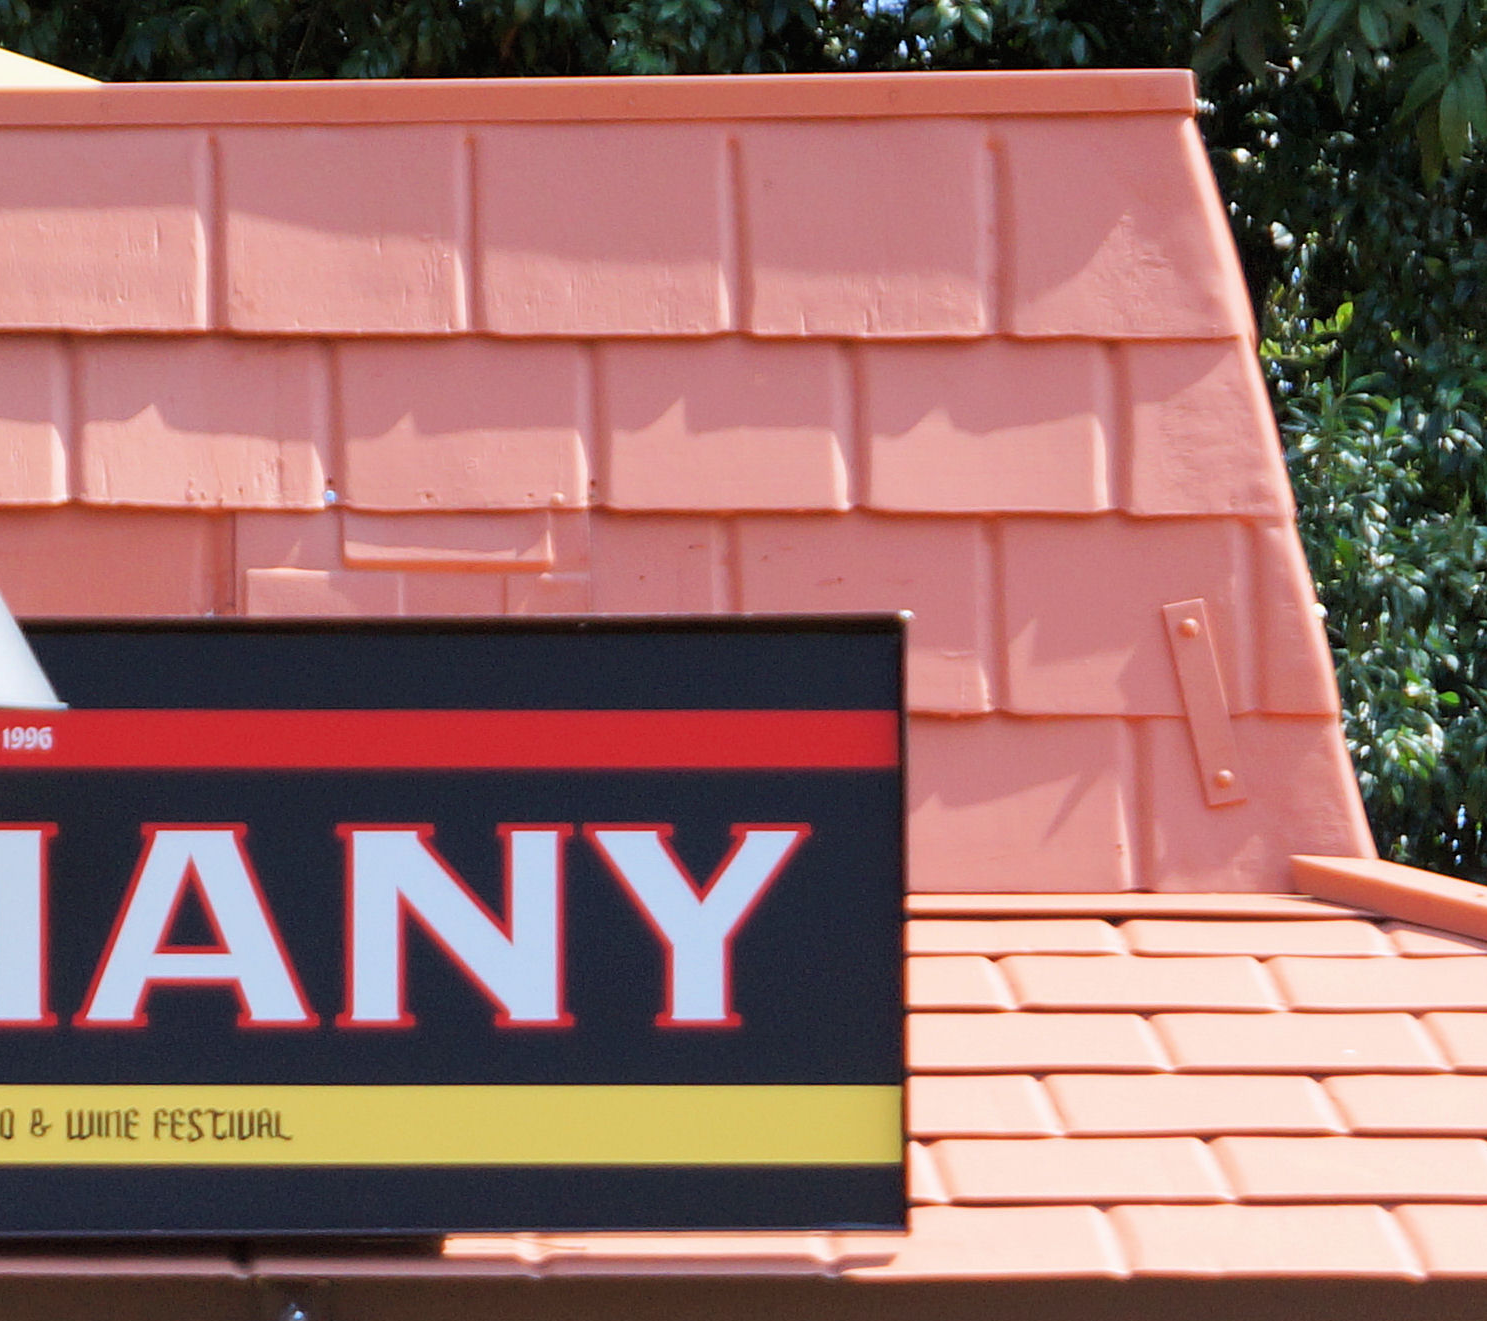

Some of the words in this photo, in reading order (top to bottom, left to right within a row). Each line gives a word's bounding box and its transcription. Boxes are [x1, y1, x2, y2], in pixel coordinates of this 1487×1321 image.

[2, 727, 52, 750] 1996
[30, 1109, 52, 1138] &
[66, 1108, 139, 1140] WINE
[153, 1109, 293, 1141] FESTIVAL
